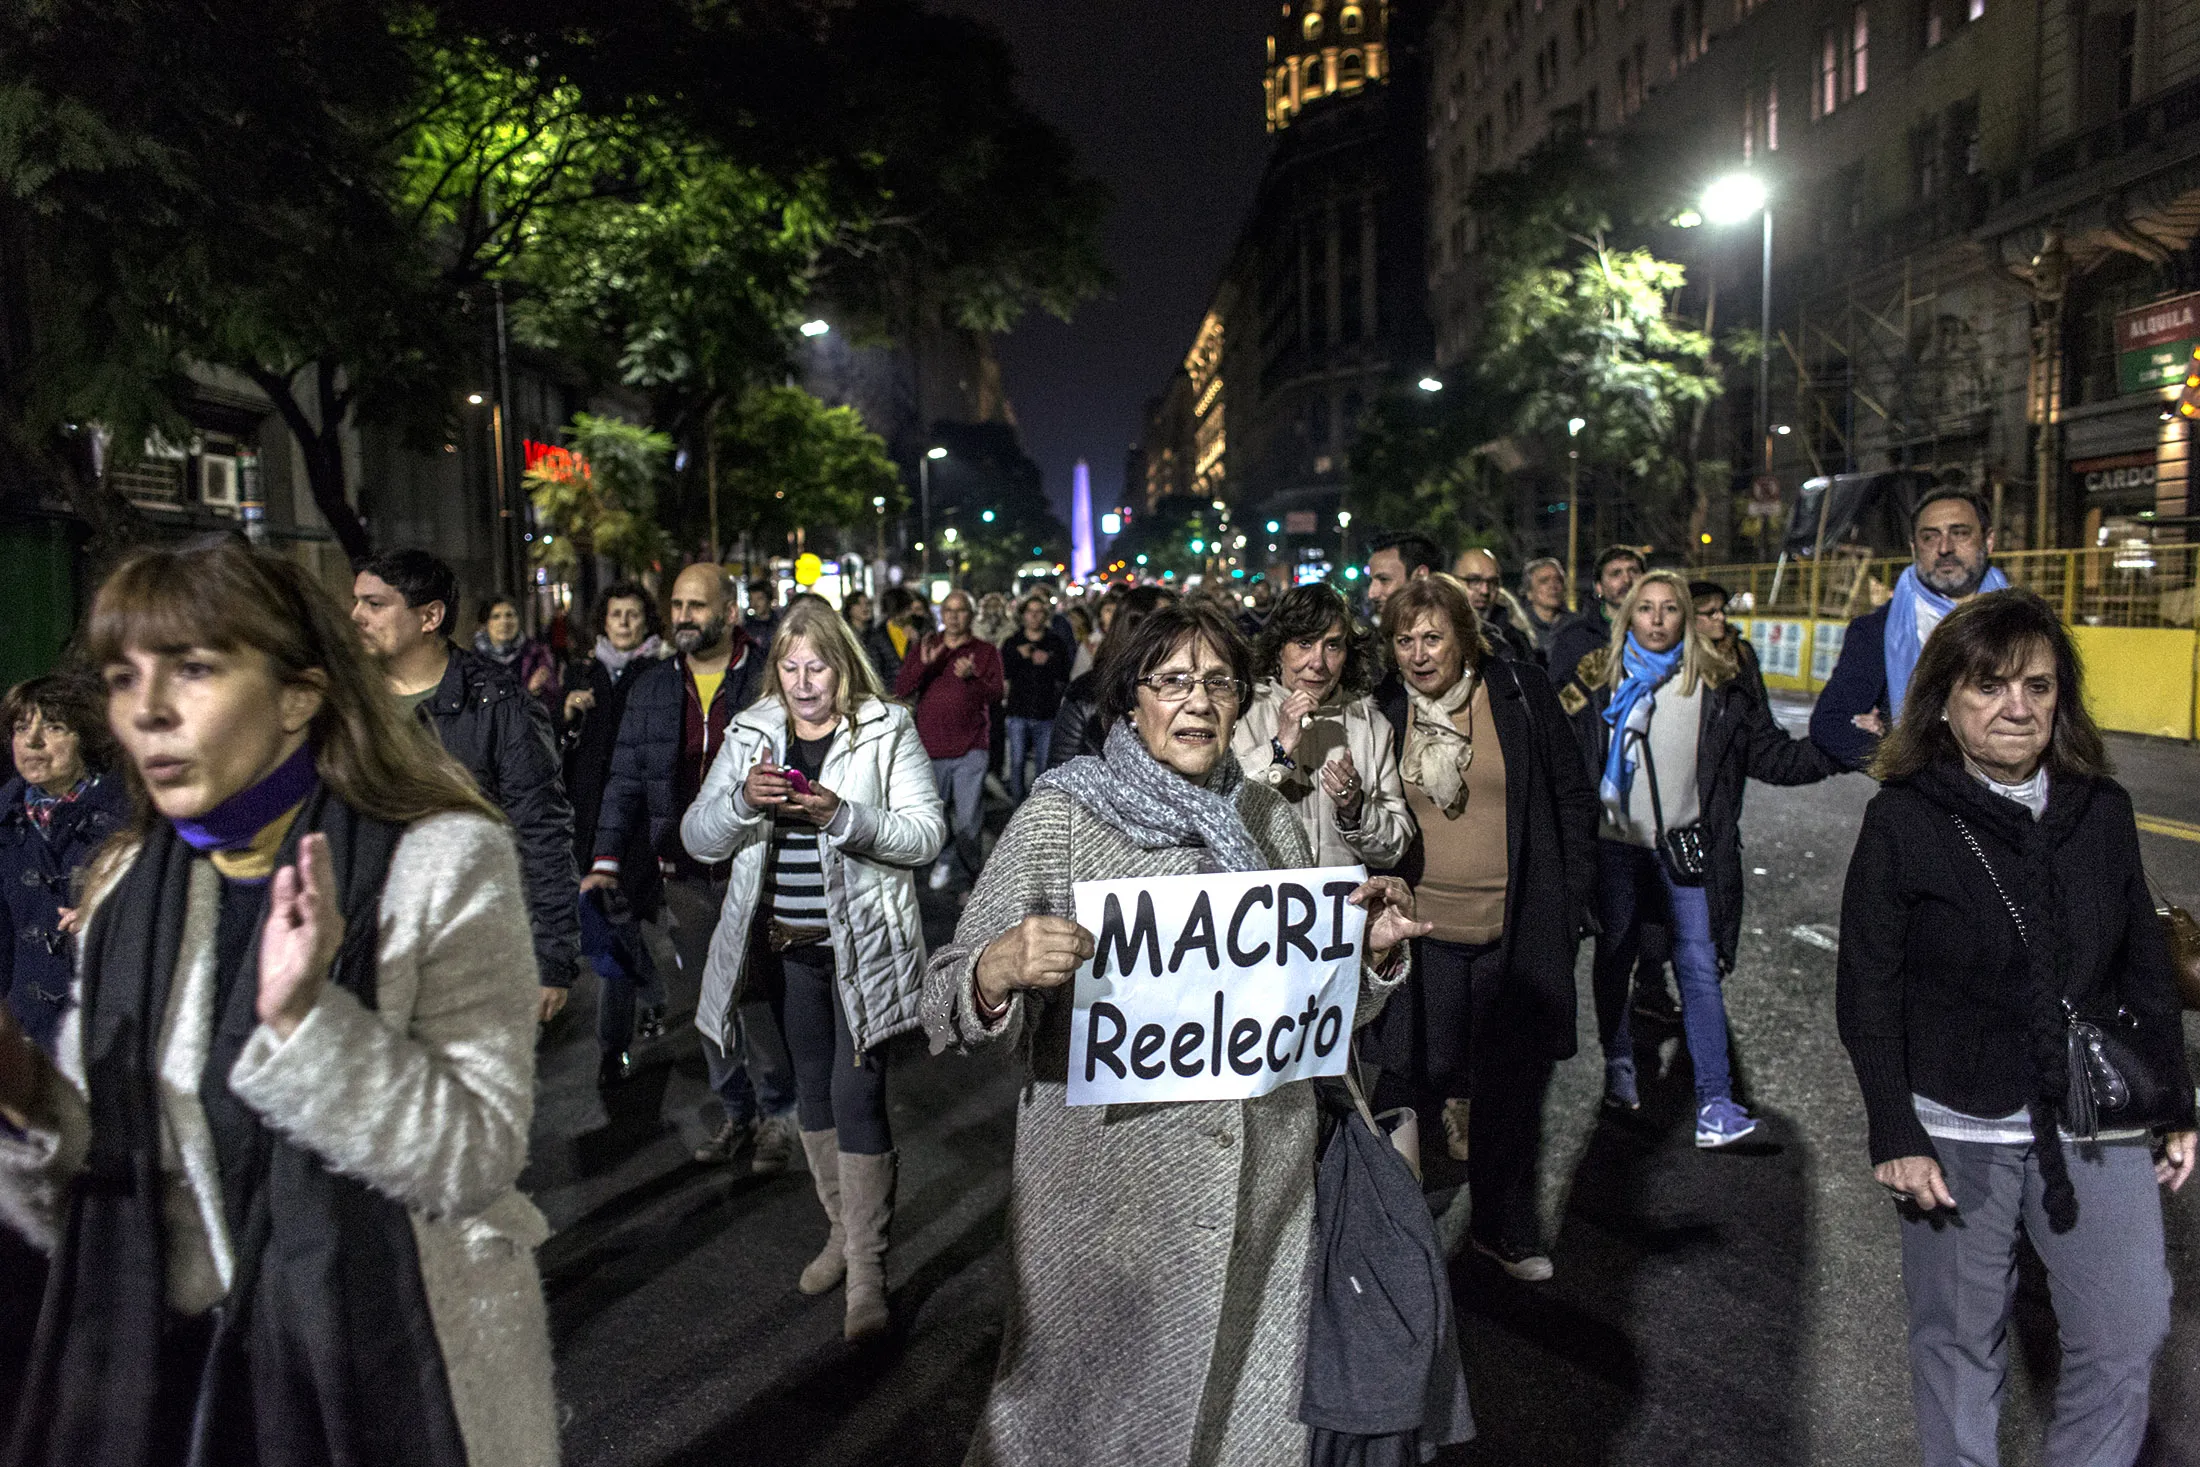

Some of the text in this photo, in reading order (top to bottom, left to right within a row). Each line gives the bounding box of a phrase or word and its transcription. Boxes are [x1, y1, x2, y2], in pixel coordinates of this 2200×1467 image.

[2129, 307, 2194, 339] ALQUILA
[1092, 881, 1360, 979] MACRI
[1085, 990, 1342, 1082] Reelecto
